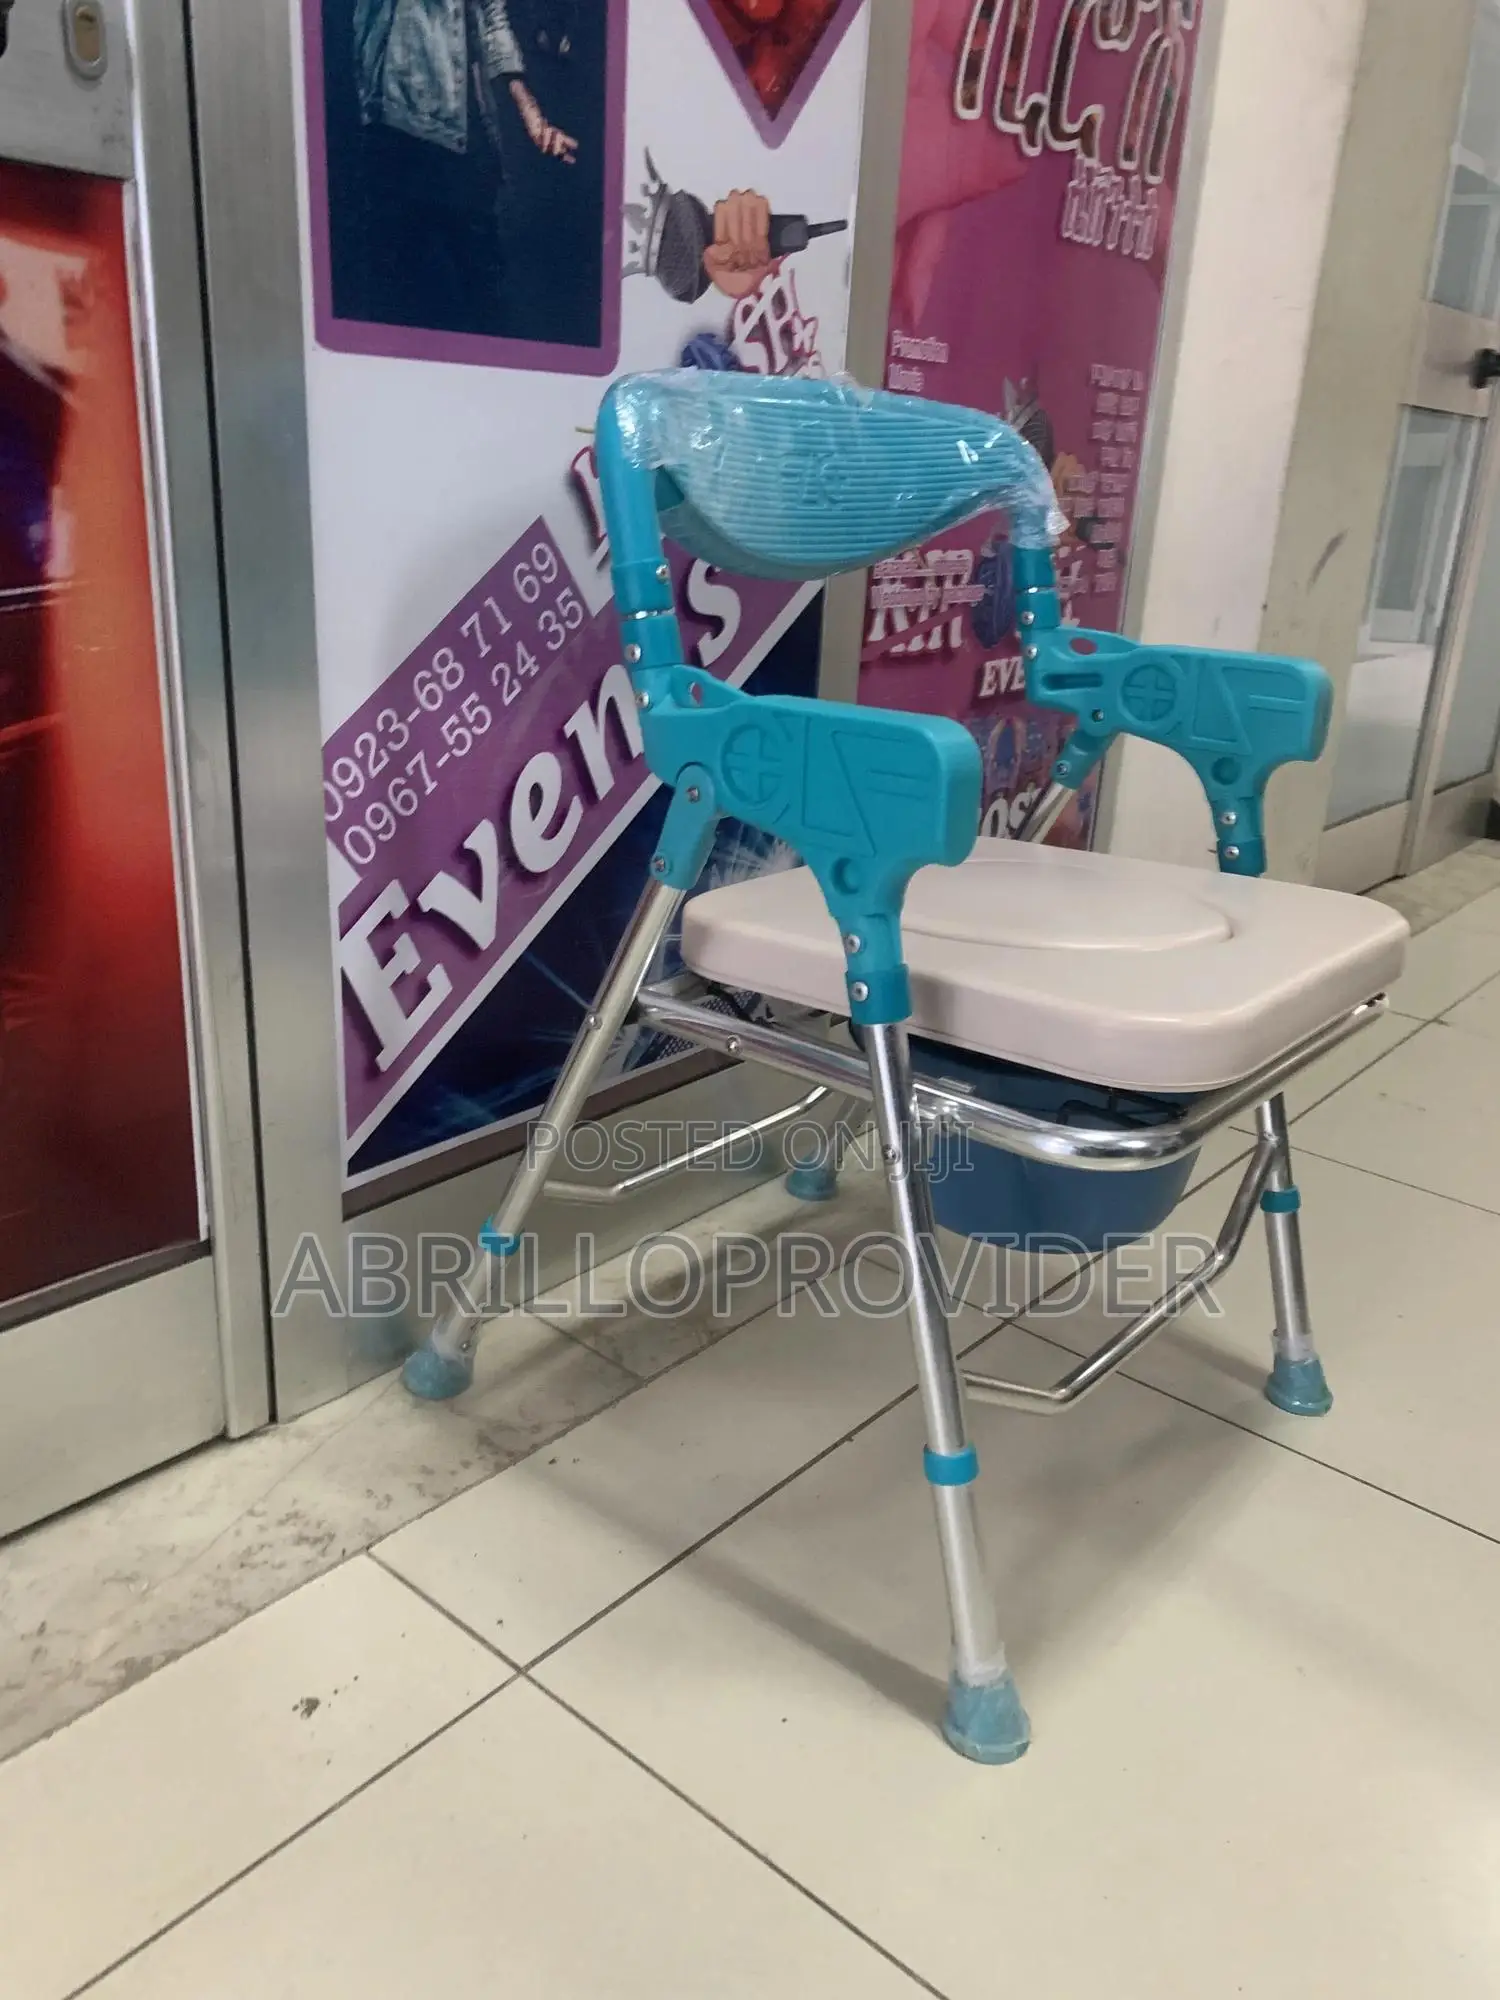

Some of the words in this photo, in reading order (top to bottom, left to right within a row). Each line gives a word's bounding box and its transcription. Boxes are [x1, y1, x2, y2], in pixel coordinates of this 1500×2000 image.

[343, 692, 492, 865] 0967-55
[491, 640, 540, 706] 24
[537, 586, 584, 651] 35
[460, 596, 513, 658] 71
[512, 542, 559, 603] 69
[339, 558, 742, 1073] Evens
